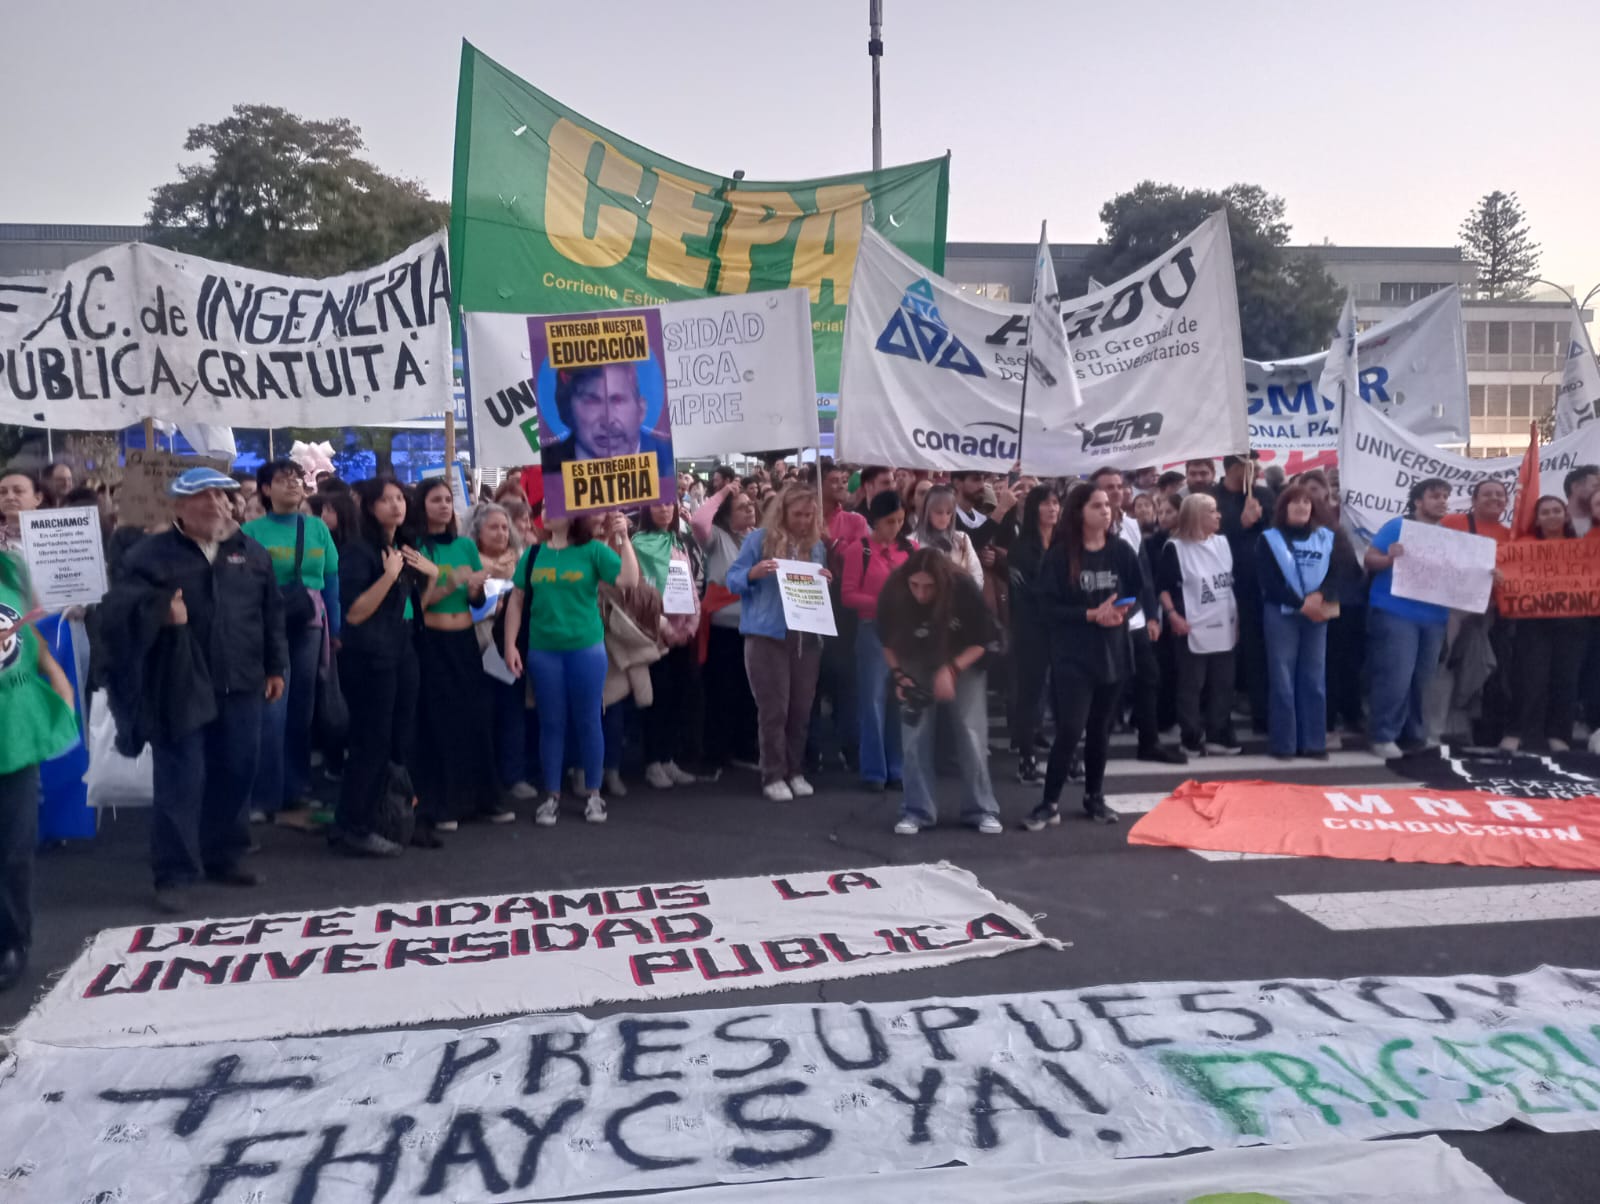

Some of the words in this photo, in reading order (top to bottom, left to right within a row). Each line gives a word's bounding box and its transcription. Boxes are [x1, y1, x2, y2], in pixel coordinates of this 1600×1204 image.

[544, 117, 872, 304] CEPA
[543, 272, 619, 300] Corriente
[139, 284, 188, 337] de
[1177, 316, 1198, 335] de
[550, 321, 601, 338] ENTREGAR
[602, 319, 643, 334] NUESTRA
[552, 332, 647, 366] EDUCACIÓN
[913, 427, 1019, 460] conadu
[572, 464, 584, 477] ES
[587, 459, 635, 475] ENTREGAR
[637, 455, 651, 470] LA
[573, 470, 653, 507] PATRIA
[30, 516, 90, 530] MARCHAMOS
[127, 885, 711, 953] DEFENDAMOS
[771, 872, 882, 900] LA
[83, 912, 713, 998] UNIVERSIDAD
[427, 981, 1456, 1104] PRESUPUESTO
